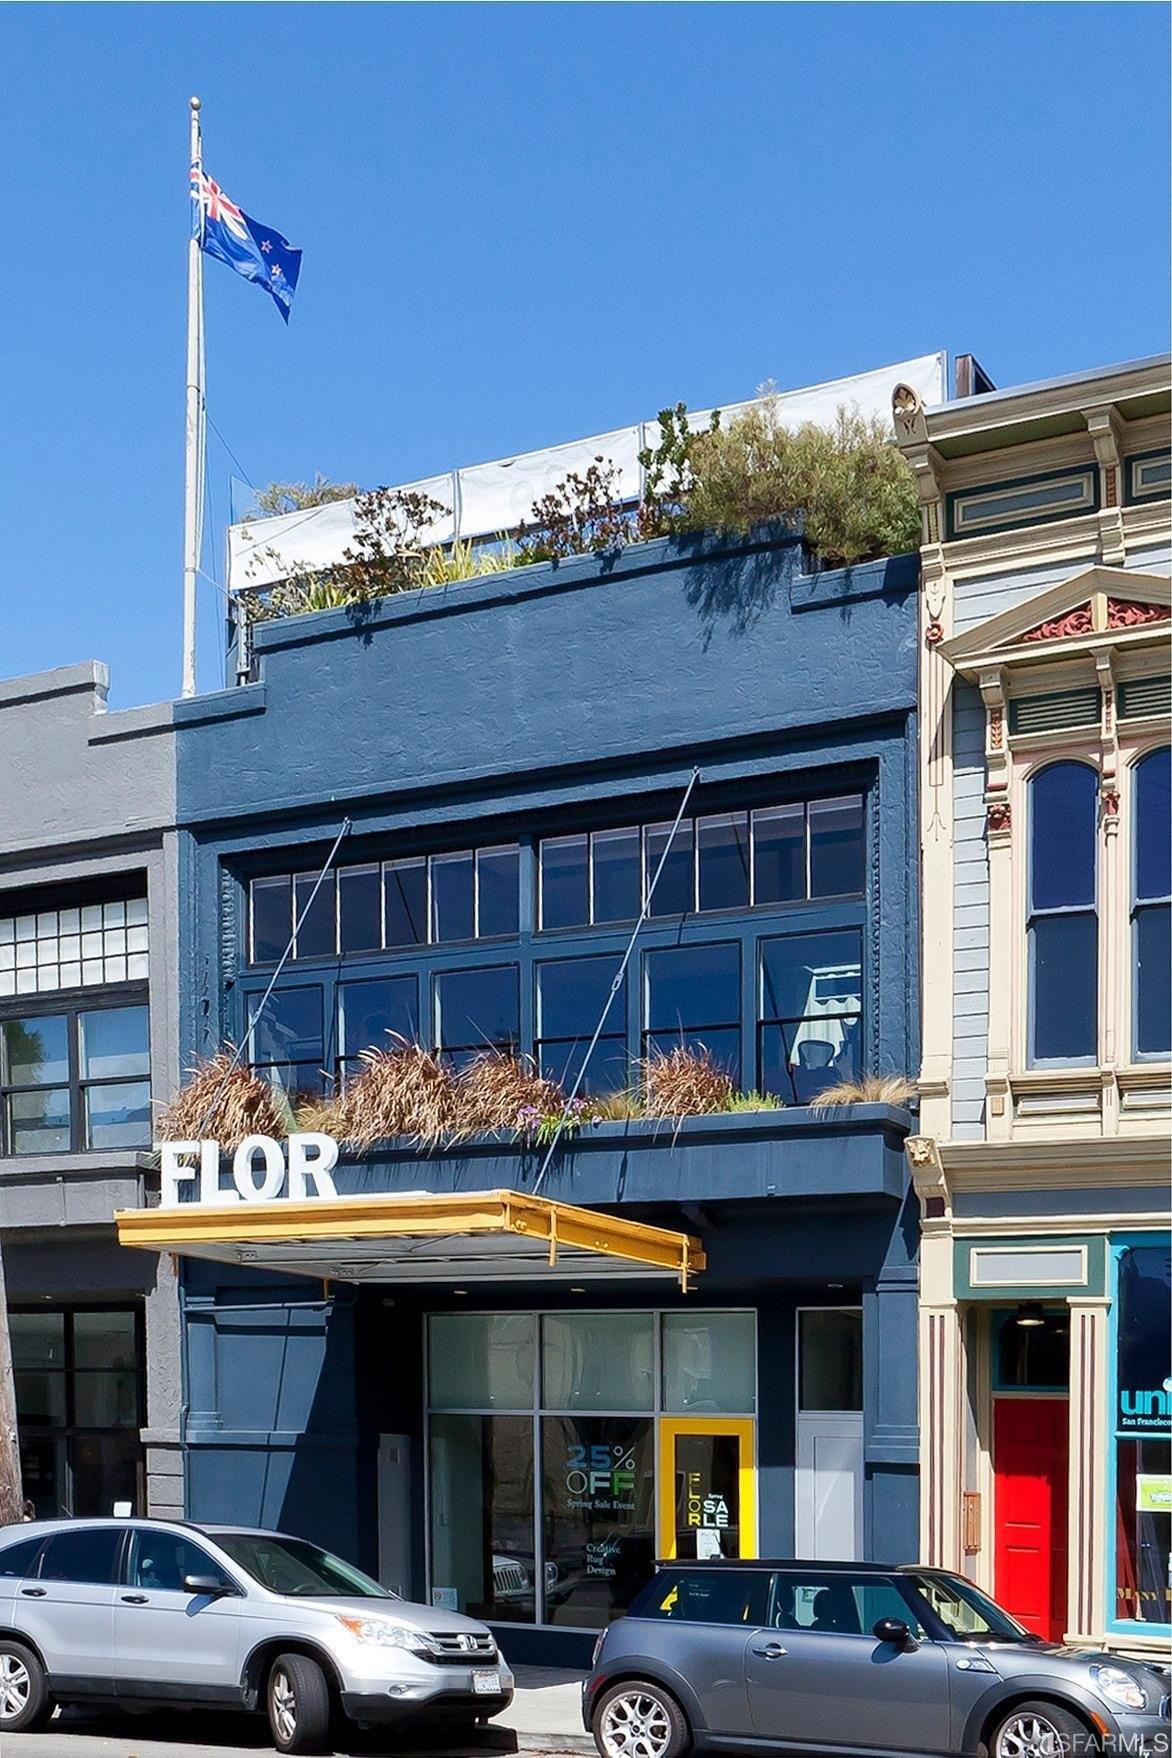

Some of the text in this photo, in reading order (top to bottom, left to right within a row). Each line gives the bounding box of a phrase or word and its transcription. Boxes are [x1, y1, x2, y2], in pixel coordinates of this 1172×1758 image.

[161, 1132, 340, 1208] FLOR
[1122, 1417, 1136, 1426] San
[566, 1445, 636, 1470] 25%
[566, 1470, 636, 1495] OFF
[566, 1498, 636, 1511] Spring Sale Event
[688, 1472, 701, 1526] FLOR
[586, 1543, 621, 1554] Creative
[586, 1554, 604, 1566] Rug
[586, 1565, 616, 1577] Design
